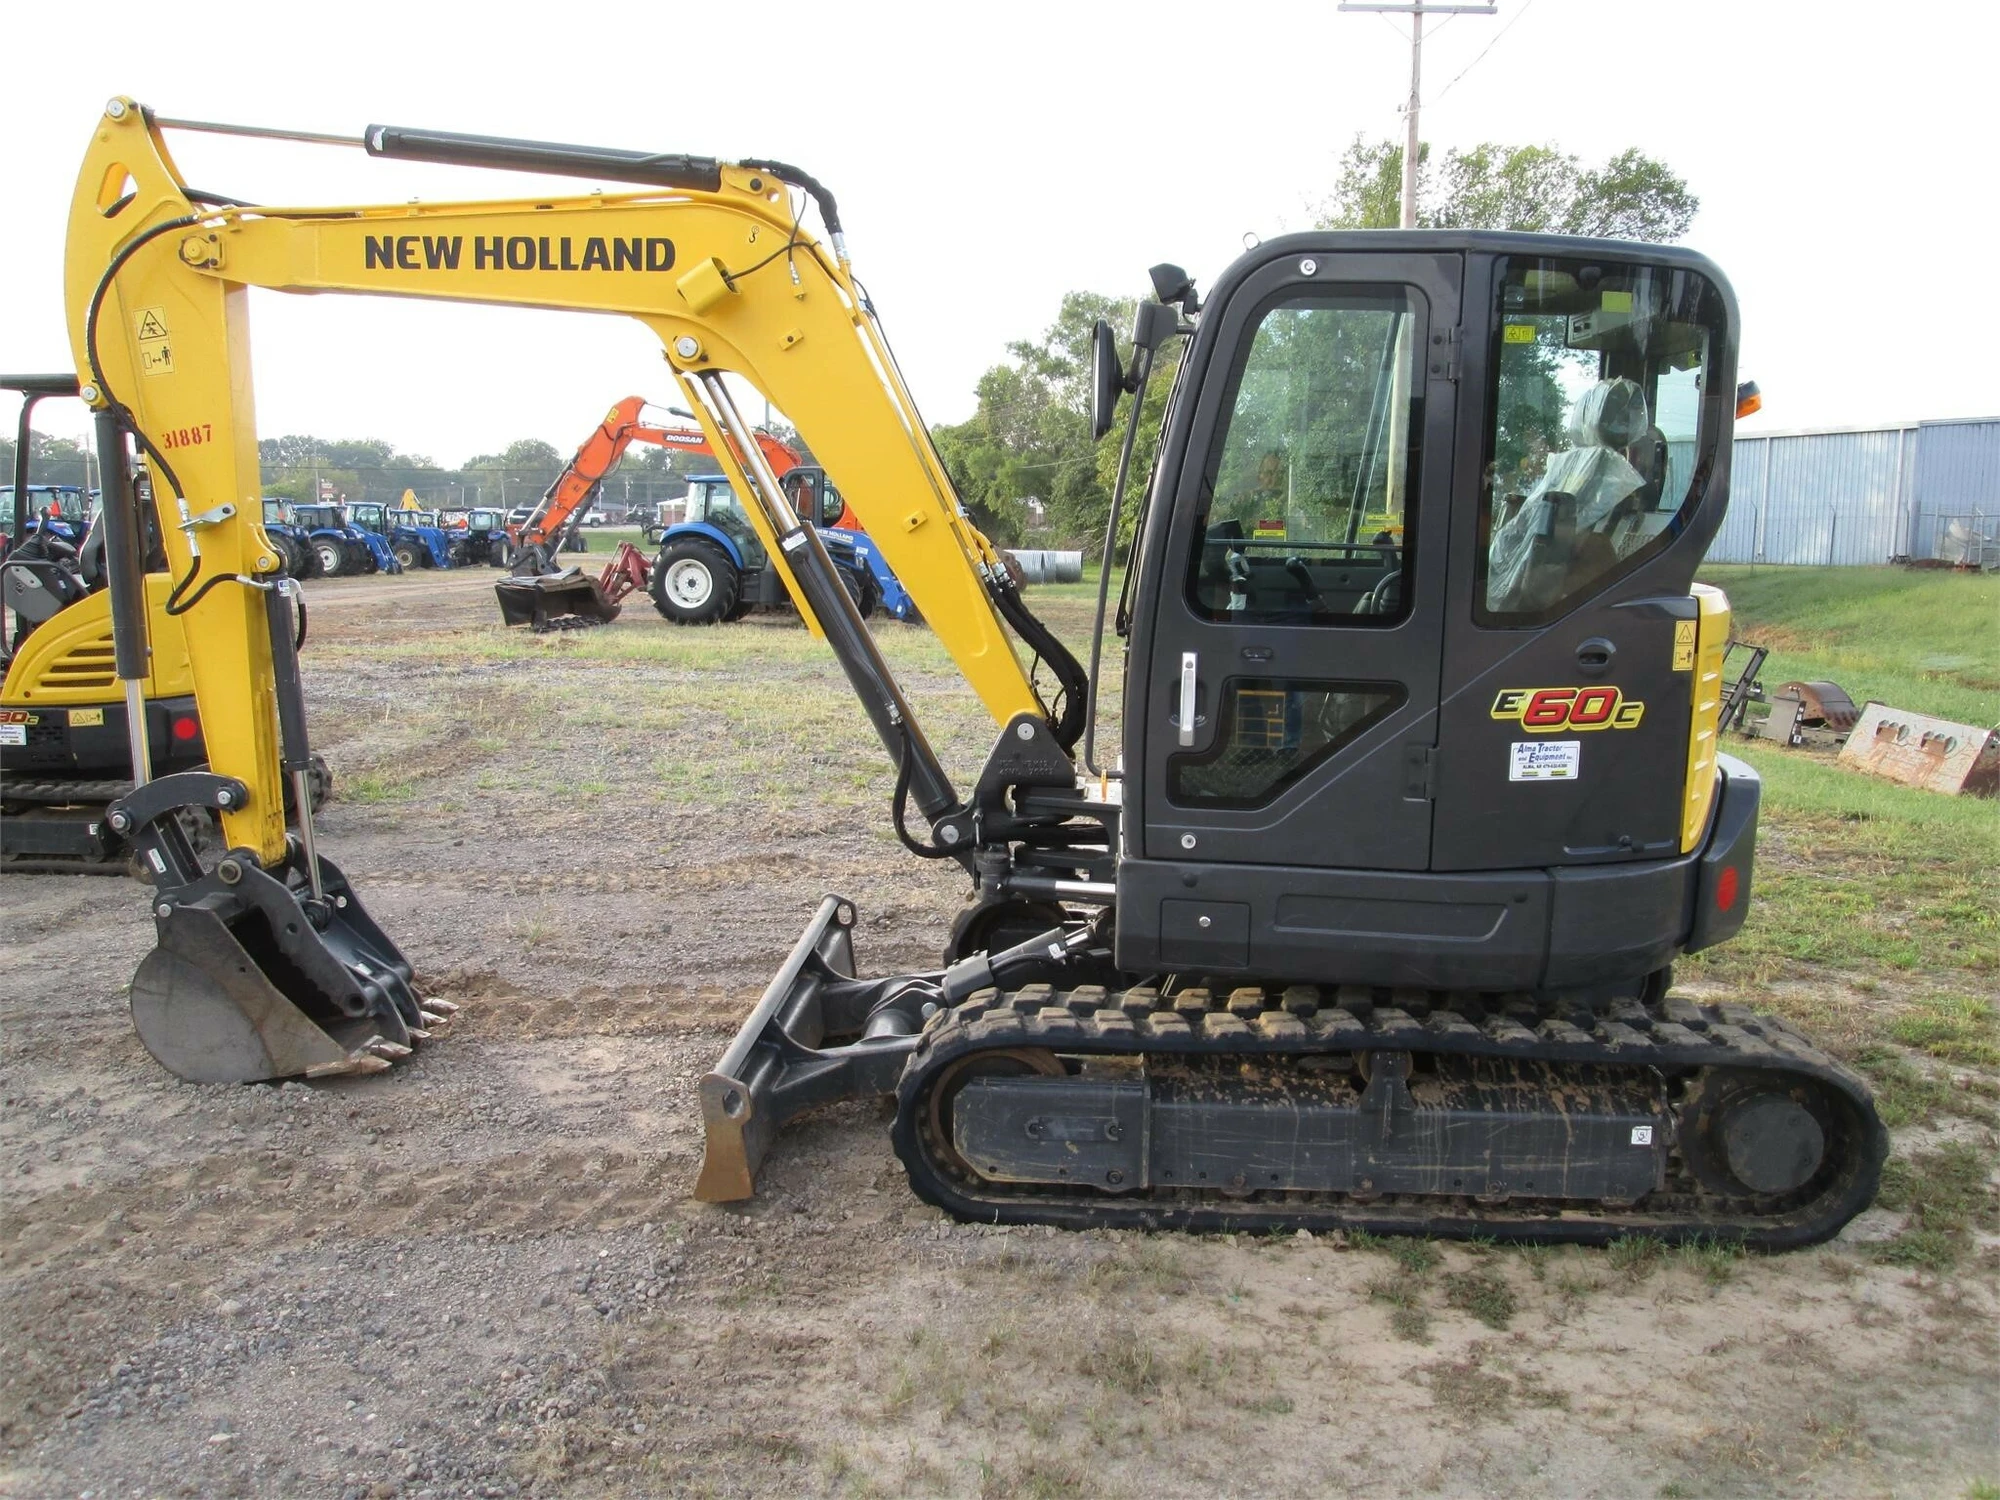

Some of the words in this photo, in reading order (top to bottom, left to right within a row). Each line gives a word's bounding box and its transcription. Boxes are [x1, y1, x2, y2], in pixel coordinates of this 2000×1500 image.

[365, 236, 463, 270] NEW
[475, 236, 676, 271] HOLLAND
[161, 424, 212, 449] 31887
[666, 434, 703, 444] DOOSAN
[829, 531, 854, 541] HOLLAND
[1517, 743, 1537, 754] Alma
[1538, 742, 1563, 753] Tractor
[1529, 753, 1566, 763] Equipment
